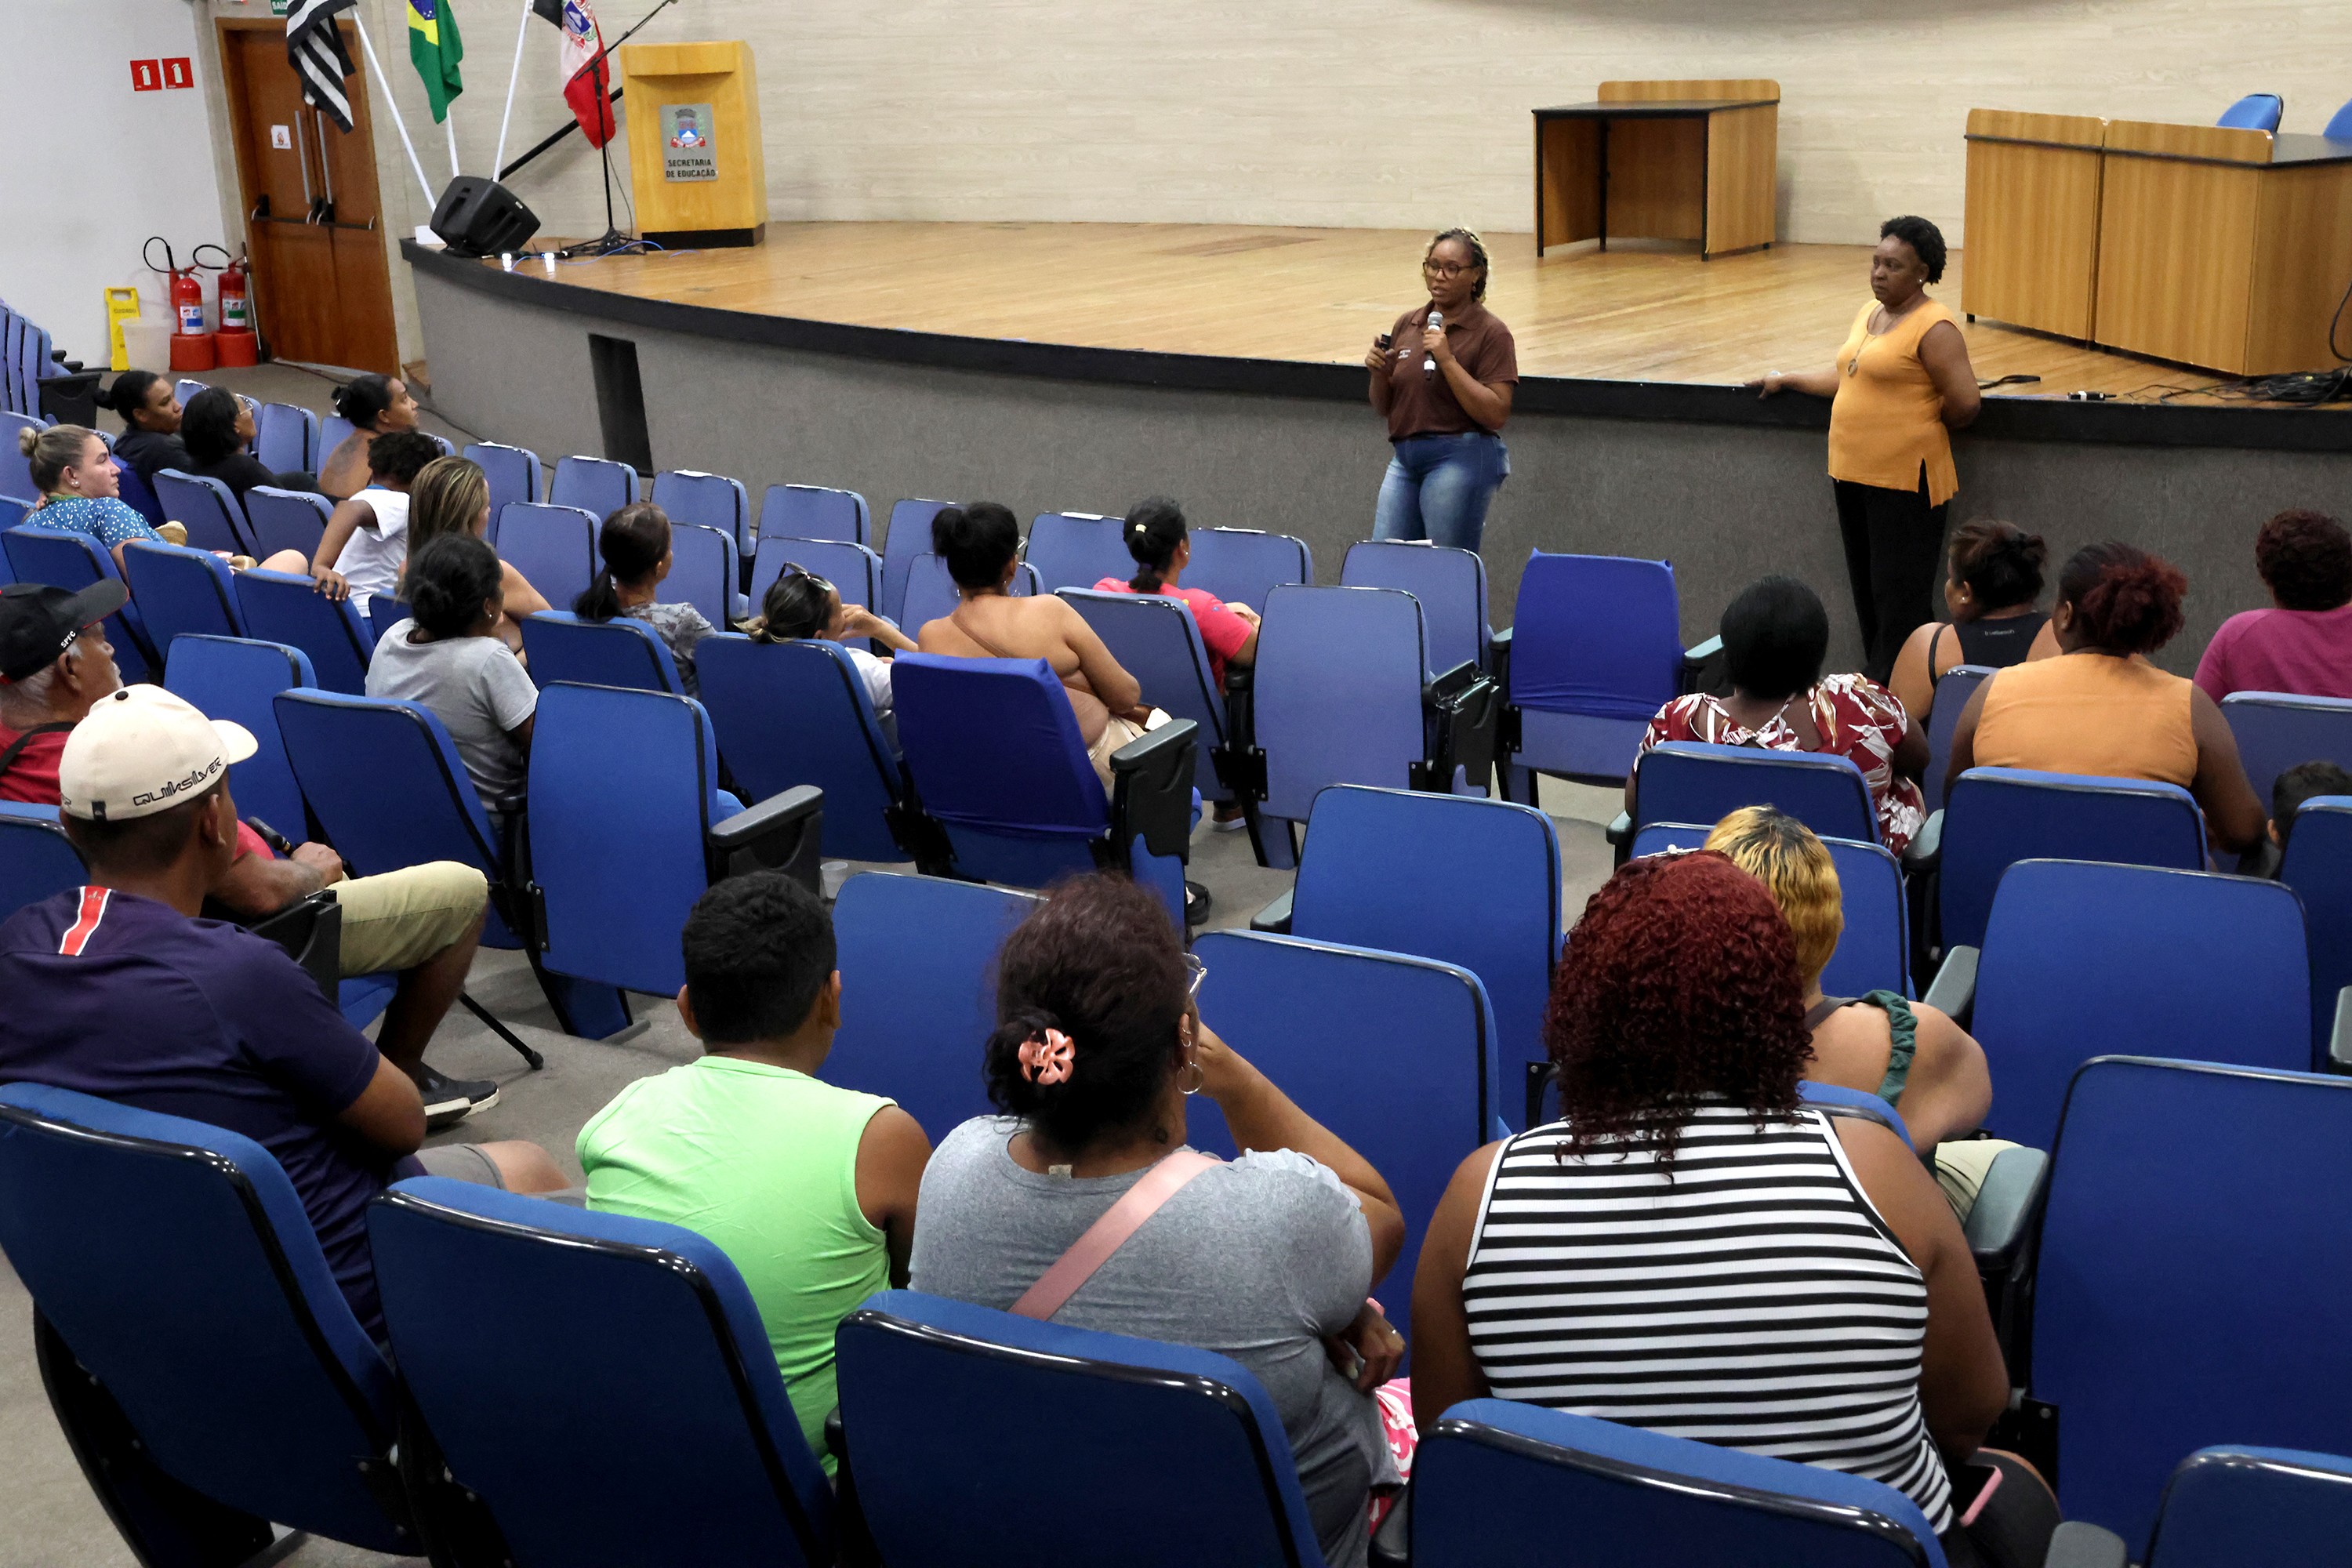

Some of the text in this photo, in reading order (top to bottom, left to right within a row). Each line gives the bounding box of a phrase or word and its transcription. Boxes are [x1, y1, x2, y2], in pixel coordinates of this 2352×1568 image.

[667, 158, 712, 167] SECRETARIA
[677, 168, 716, 179] EDUCAÇÃO
[60, 630, 76, 648] SPFC
[132, 756, 222, 807] QUIKSILVER
